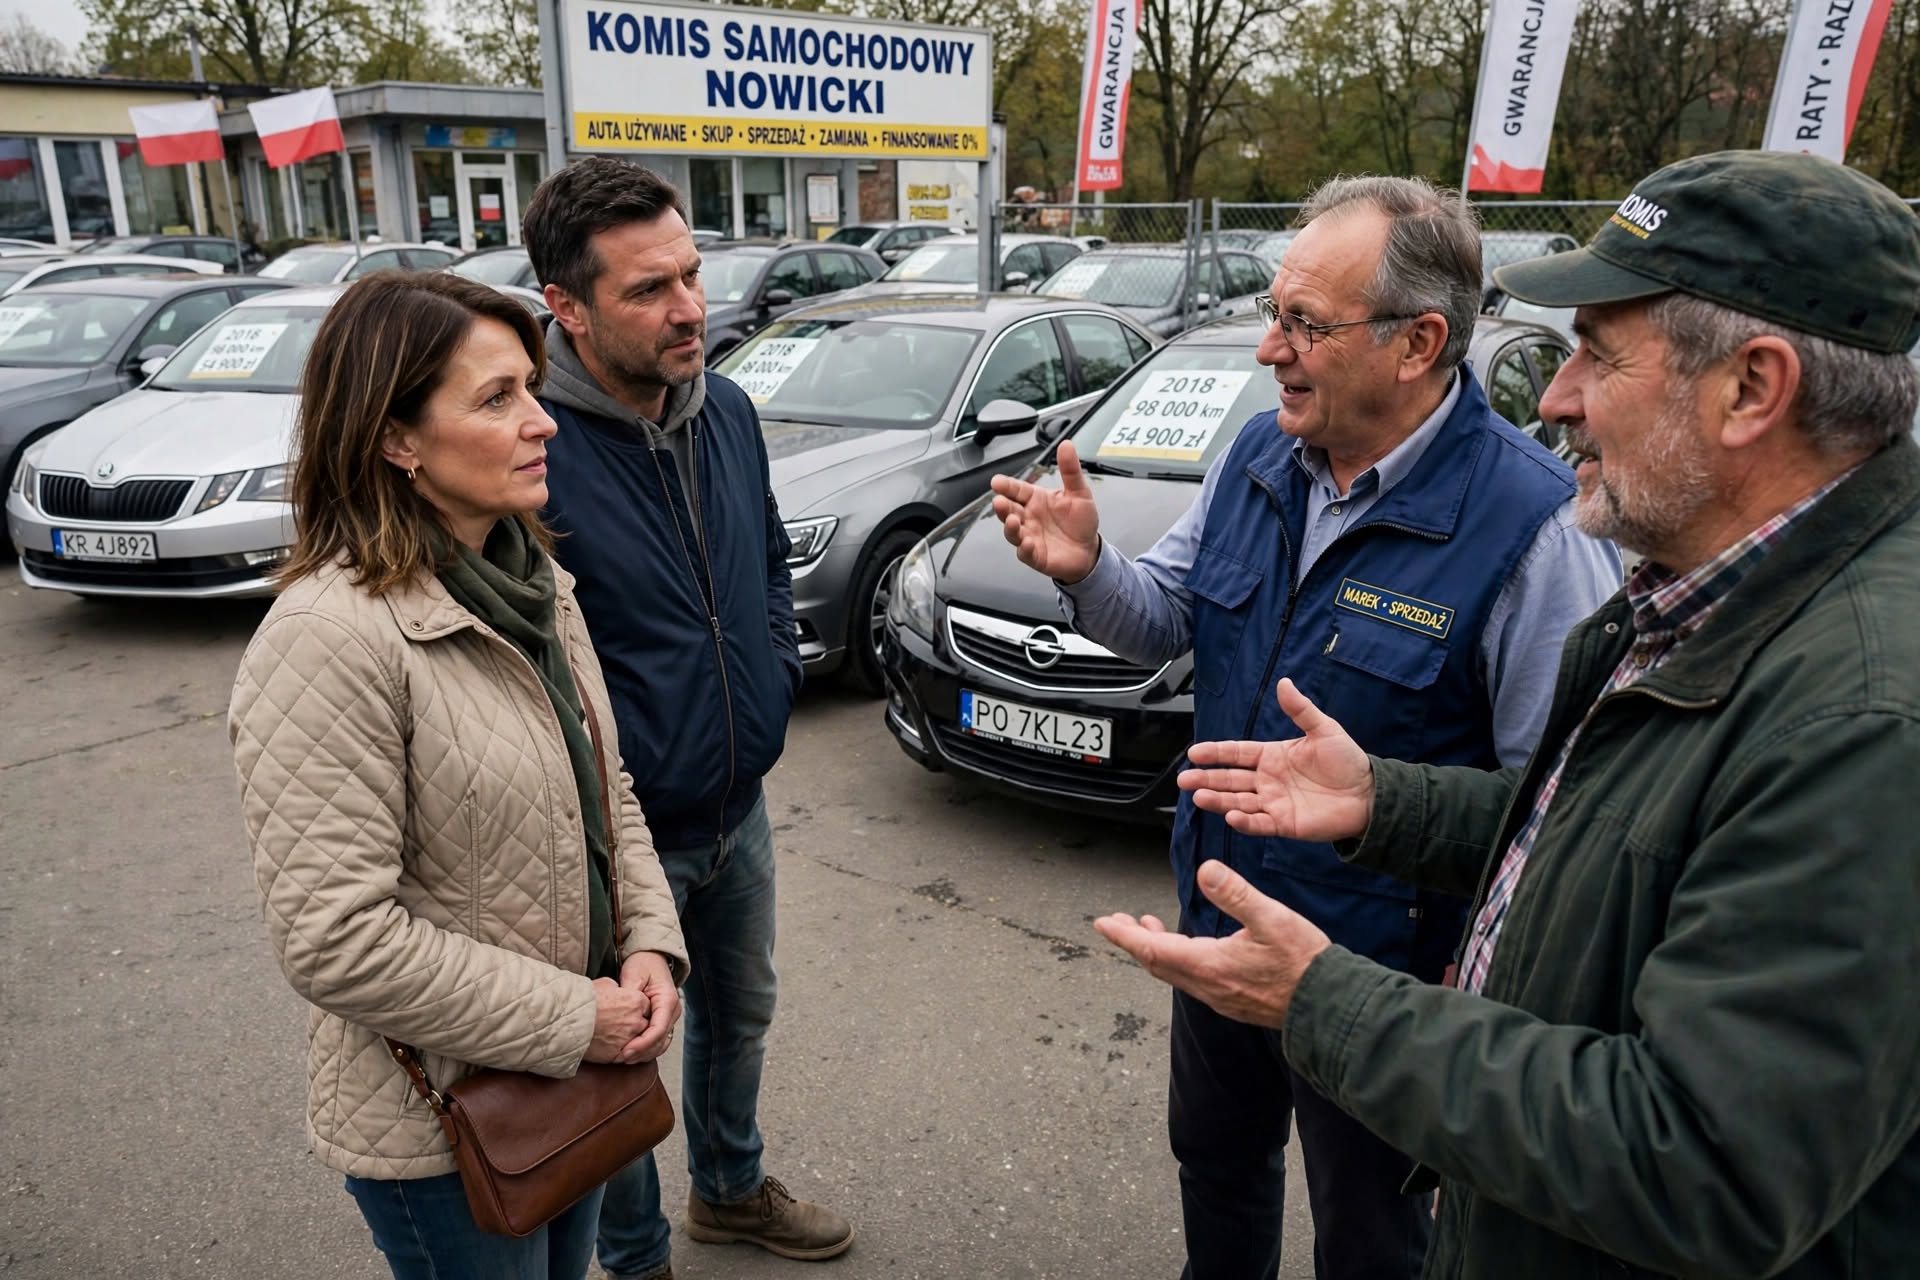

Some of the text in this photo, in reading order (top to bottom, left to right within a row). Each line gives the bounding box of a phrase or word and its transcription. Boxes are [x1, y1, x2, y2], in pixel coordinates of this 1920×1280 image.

[587, 11, 974, 75] KOMIS SAMOCHODOWY
[706, 69, 884, 114] NOWICKI
[1099, 7, 1126, 149] GWARANCJA
[1796, 74, 1831, 140] RATY
[588, 118, 978, 151] AUTA UŻYWANE SKUP SPRZEDAŻ ZAMIANA FINANSOWANIE 0%
[760, 343, 796, 356] 2018
[755, 361, 780, 374] 000
[1158, 376, 1216, 394] 2018
[1132, 400, 1225, 419] 98 000 km
[1112, 426, 1207, 448] 54 900 zł
[64, 533, 152, 557] KR 4J892
[1343, 586, 1447, 630] MAREK SPRZEDAŻ
[976, 699, 1008, 732] PO
[1018, 708, 1104, 752] 7KL23
